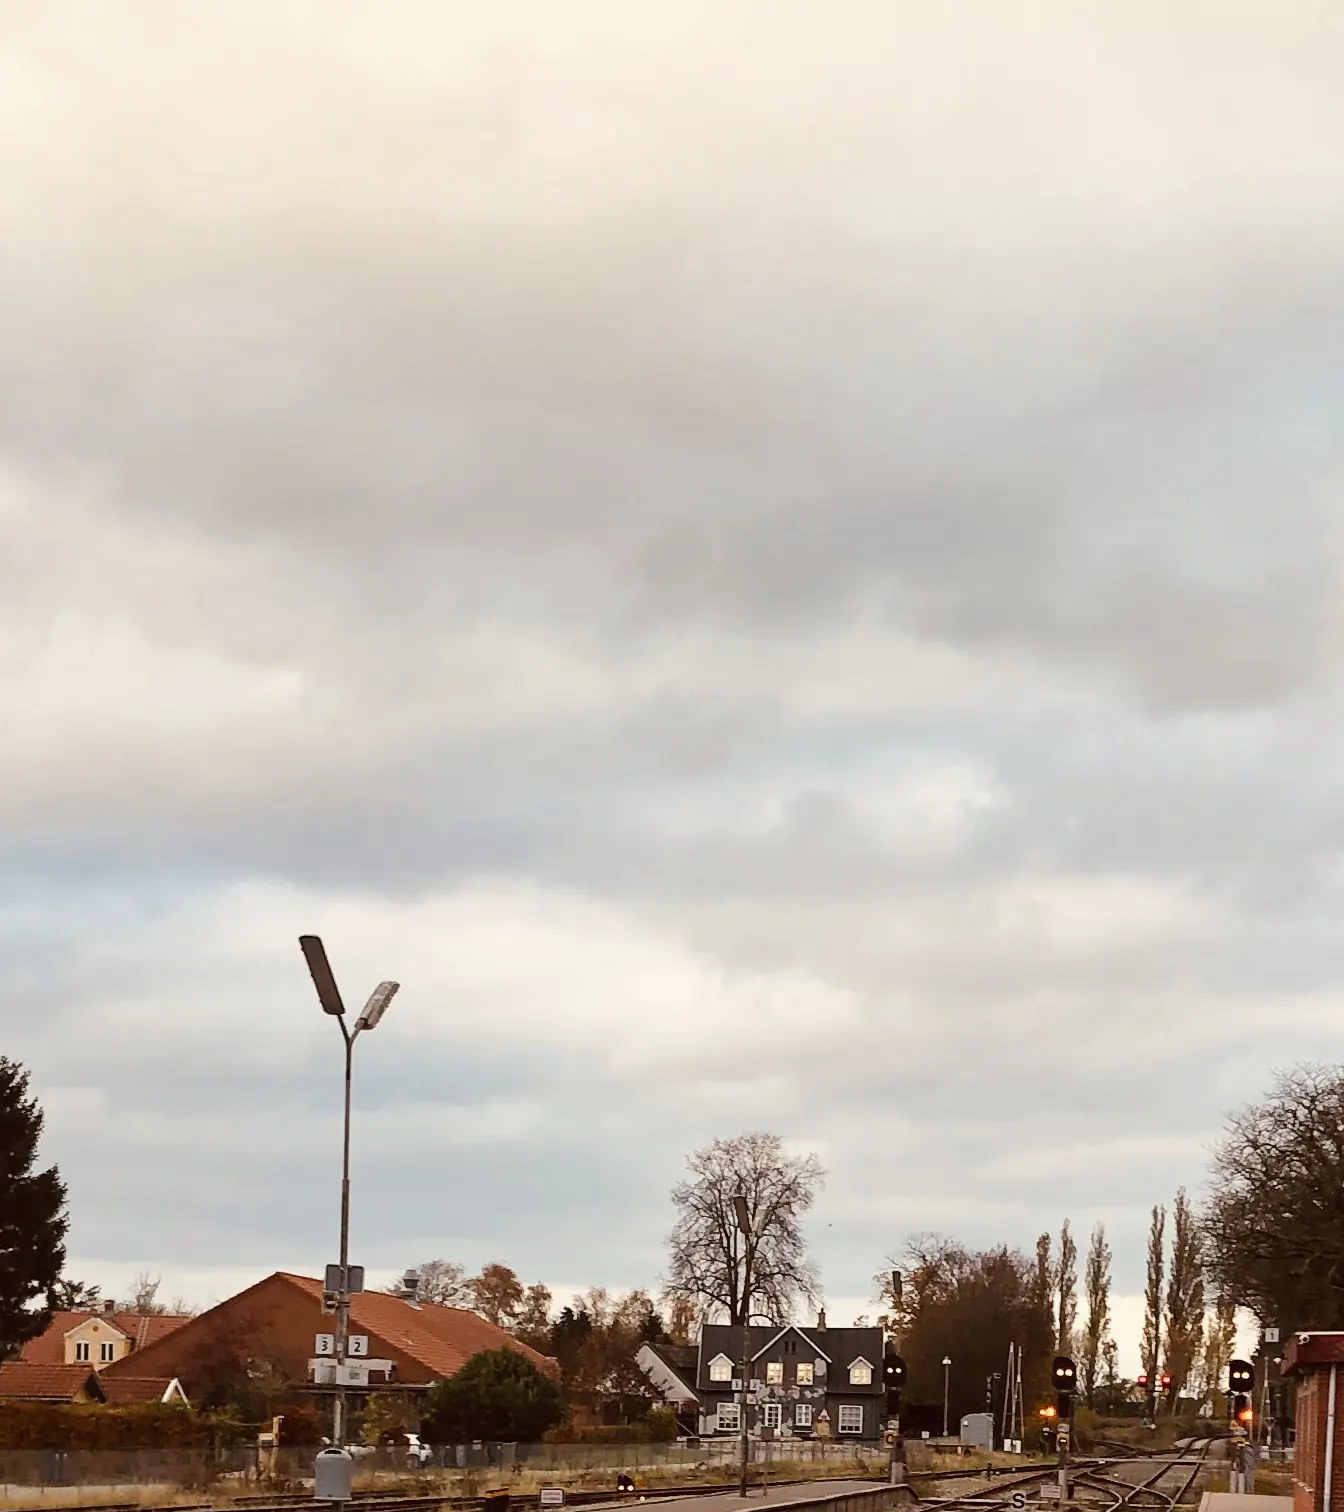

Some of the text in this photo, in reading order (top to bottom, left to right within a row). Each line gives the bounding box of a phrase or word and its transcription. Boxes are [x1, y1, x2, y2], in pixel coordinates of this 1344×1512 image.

[321, 1340, 329, 1352] 3
[353, 1341, 361, 1353] 2
[1012, 1492, 1026, 1510] S
